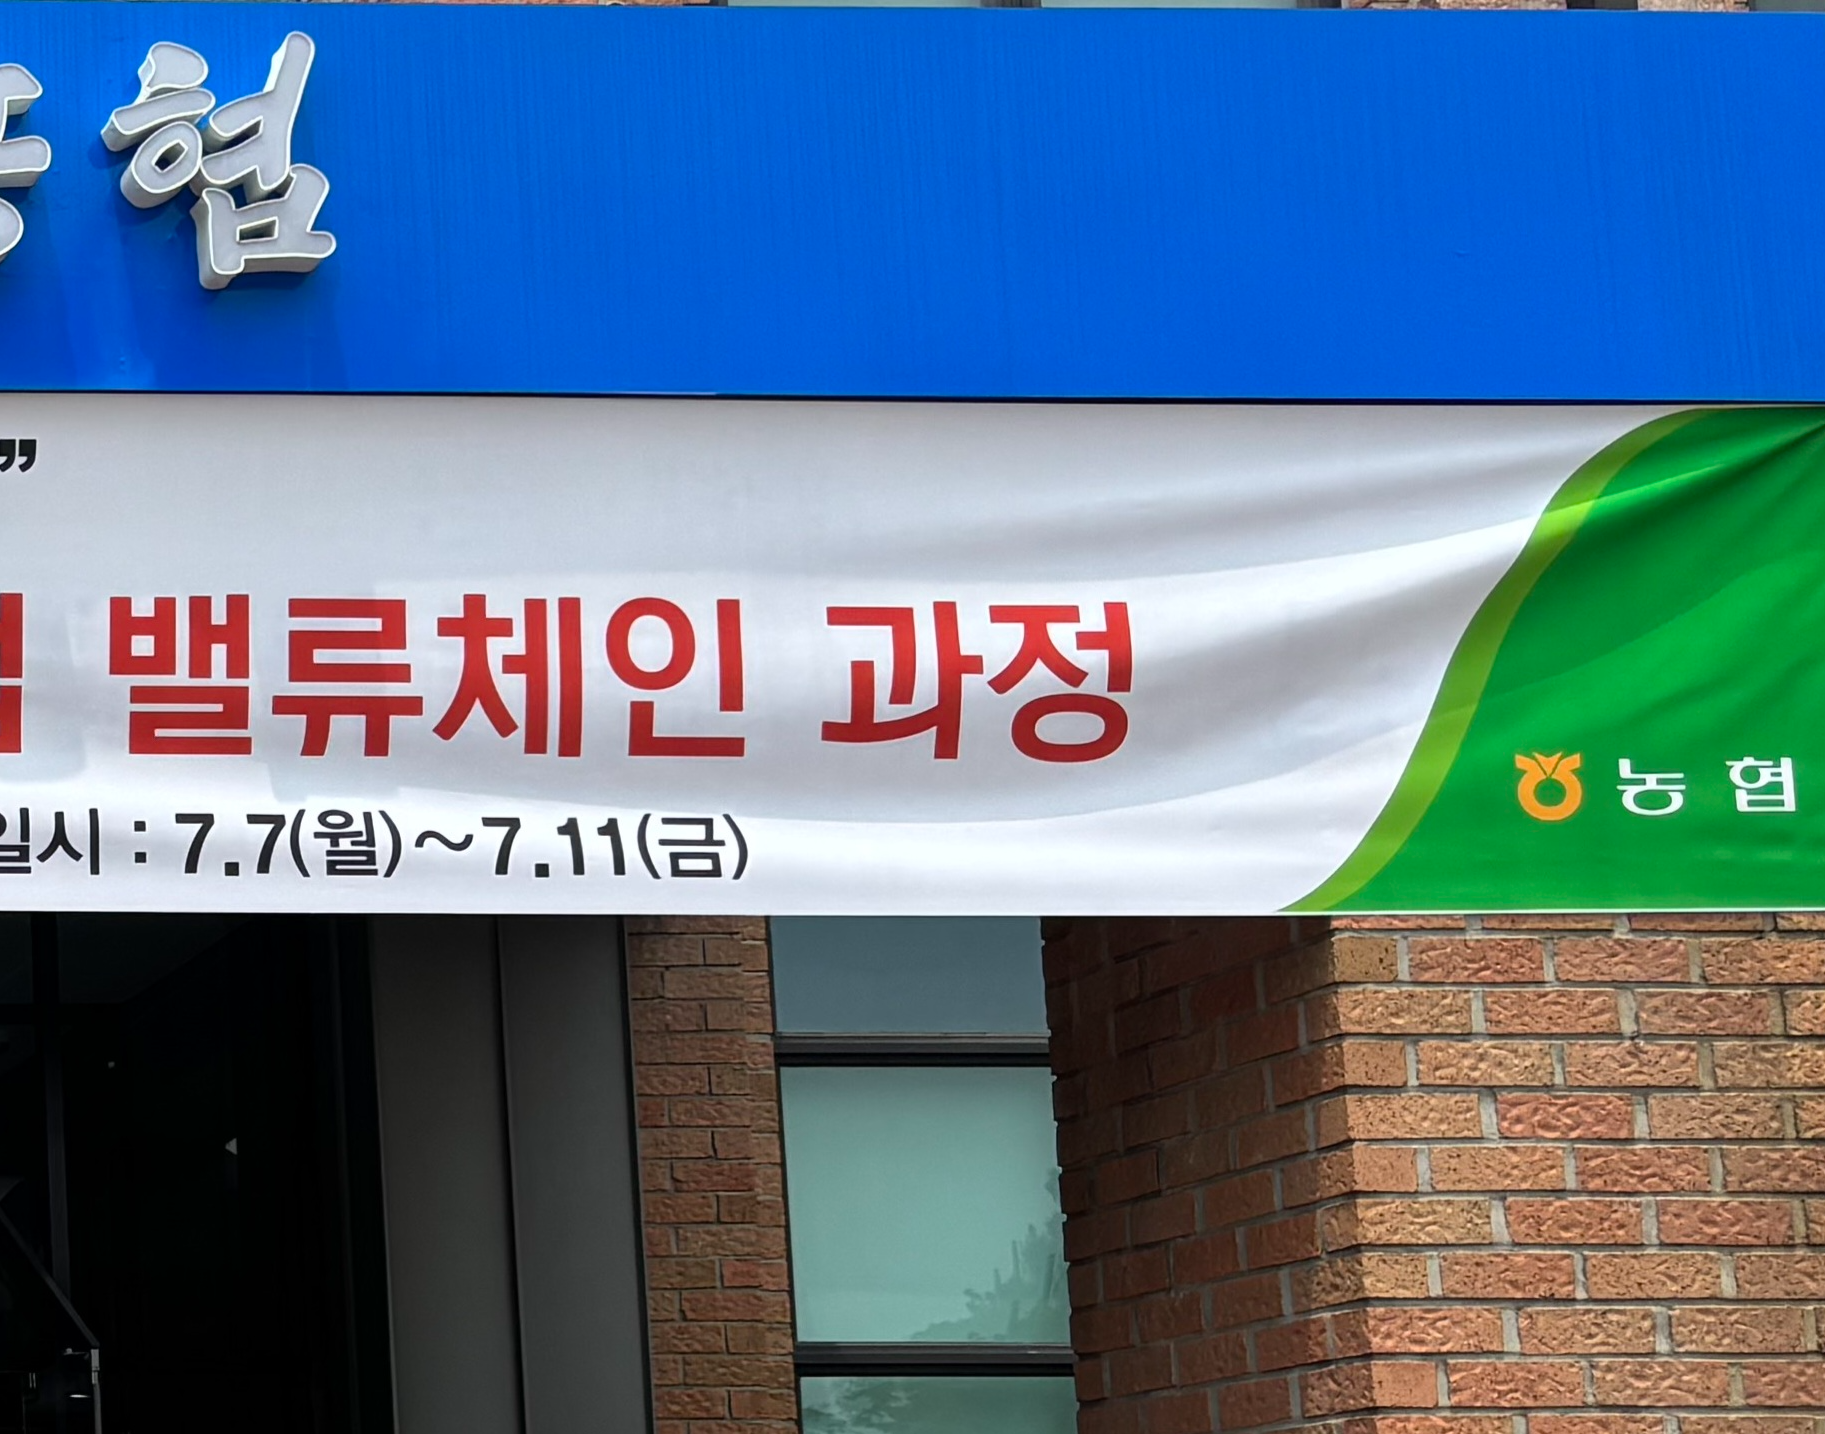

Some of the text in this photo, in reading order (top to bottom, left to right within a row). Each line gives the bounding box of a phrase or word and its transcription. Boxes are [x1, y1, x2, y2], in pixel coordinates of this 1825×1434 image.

[109, 593, 747, 758] 밸류체인
[820, 600, 1134, 763] 과정
[1616, 756, 1797, 816] 농협
